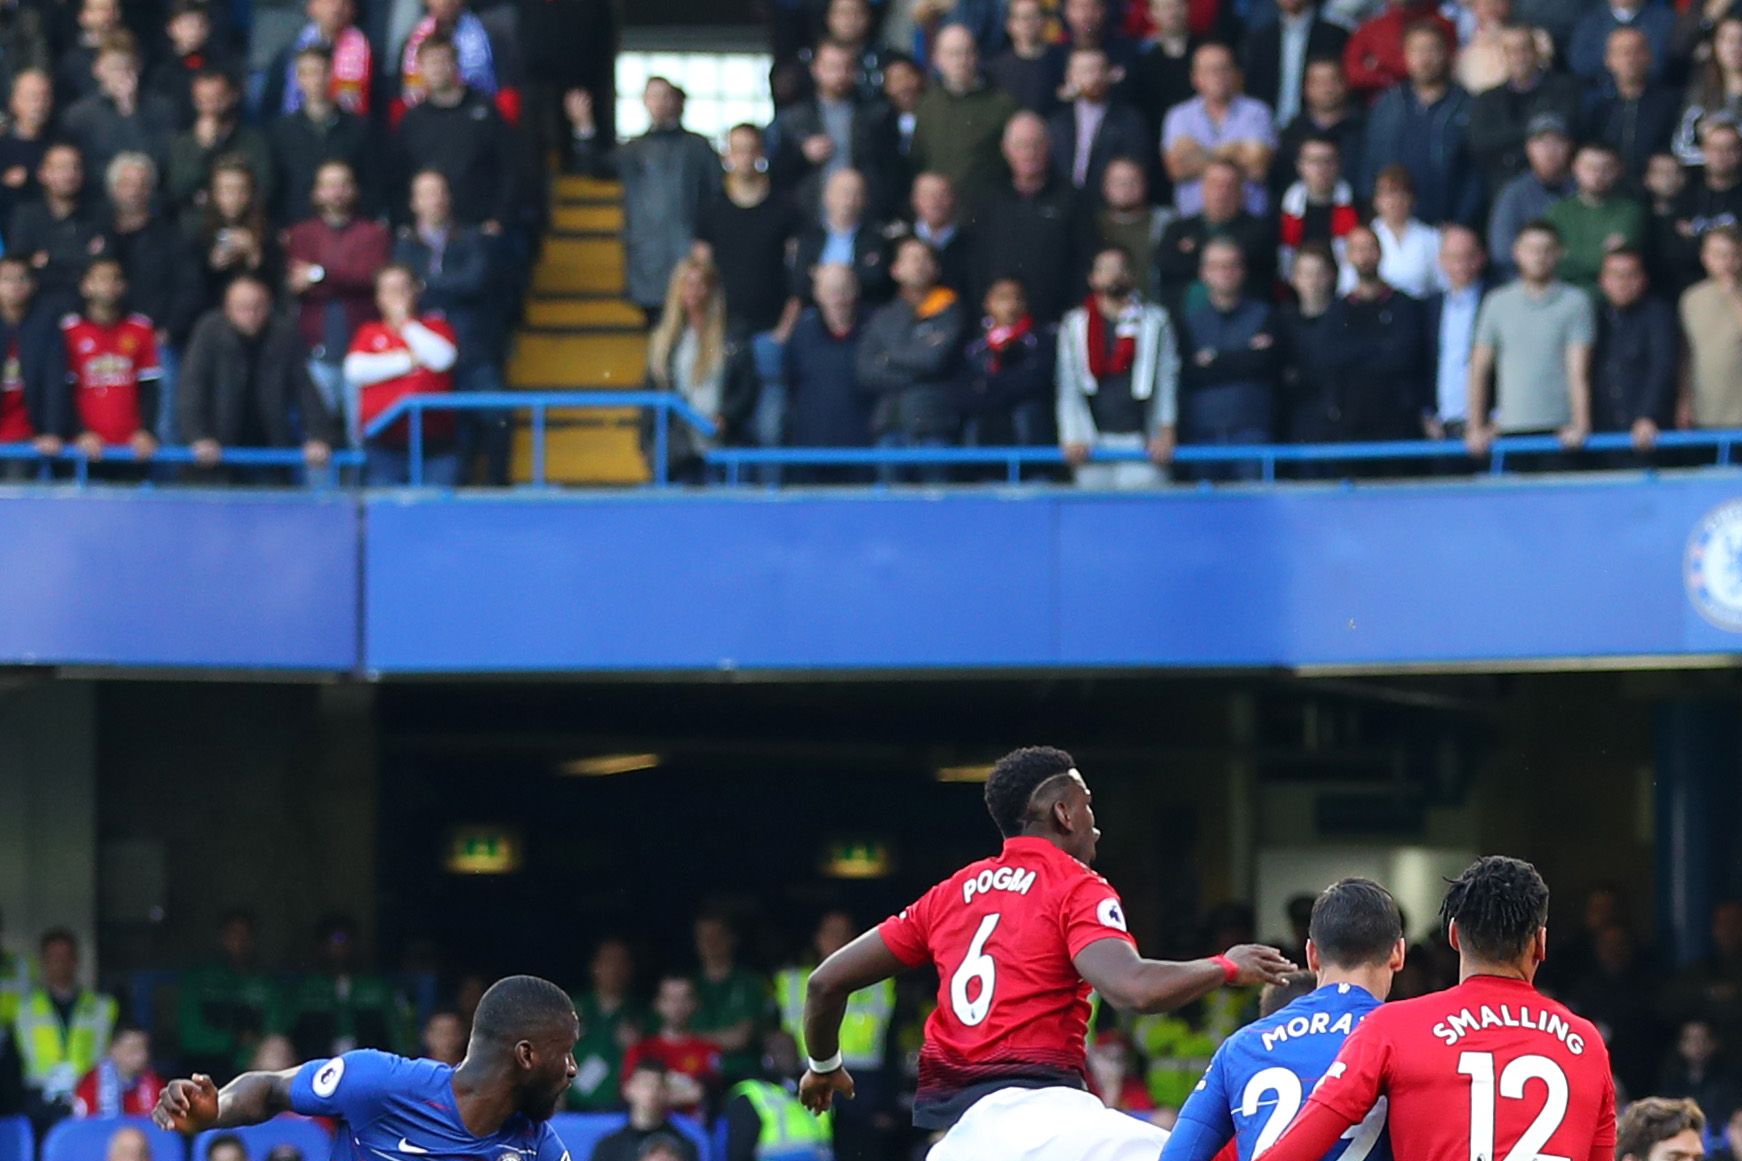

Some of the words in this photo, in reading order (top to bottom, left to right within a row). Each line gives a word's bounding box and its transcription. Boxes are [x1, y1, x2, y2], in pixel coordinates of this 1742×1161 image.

[963, 866, 1037, 904] POGBA
[951, 912, 996, 1027] 6
[1261, 1012, 1365, 1051] MORA
[1432, 1004, 1585, 1055] SMALLING
